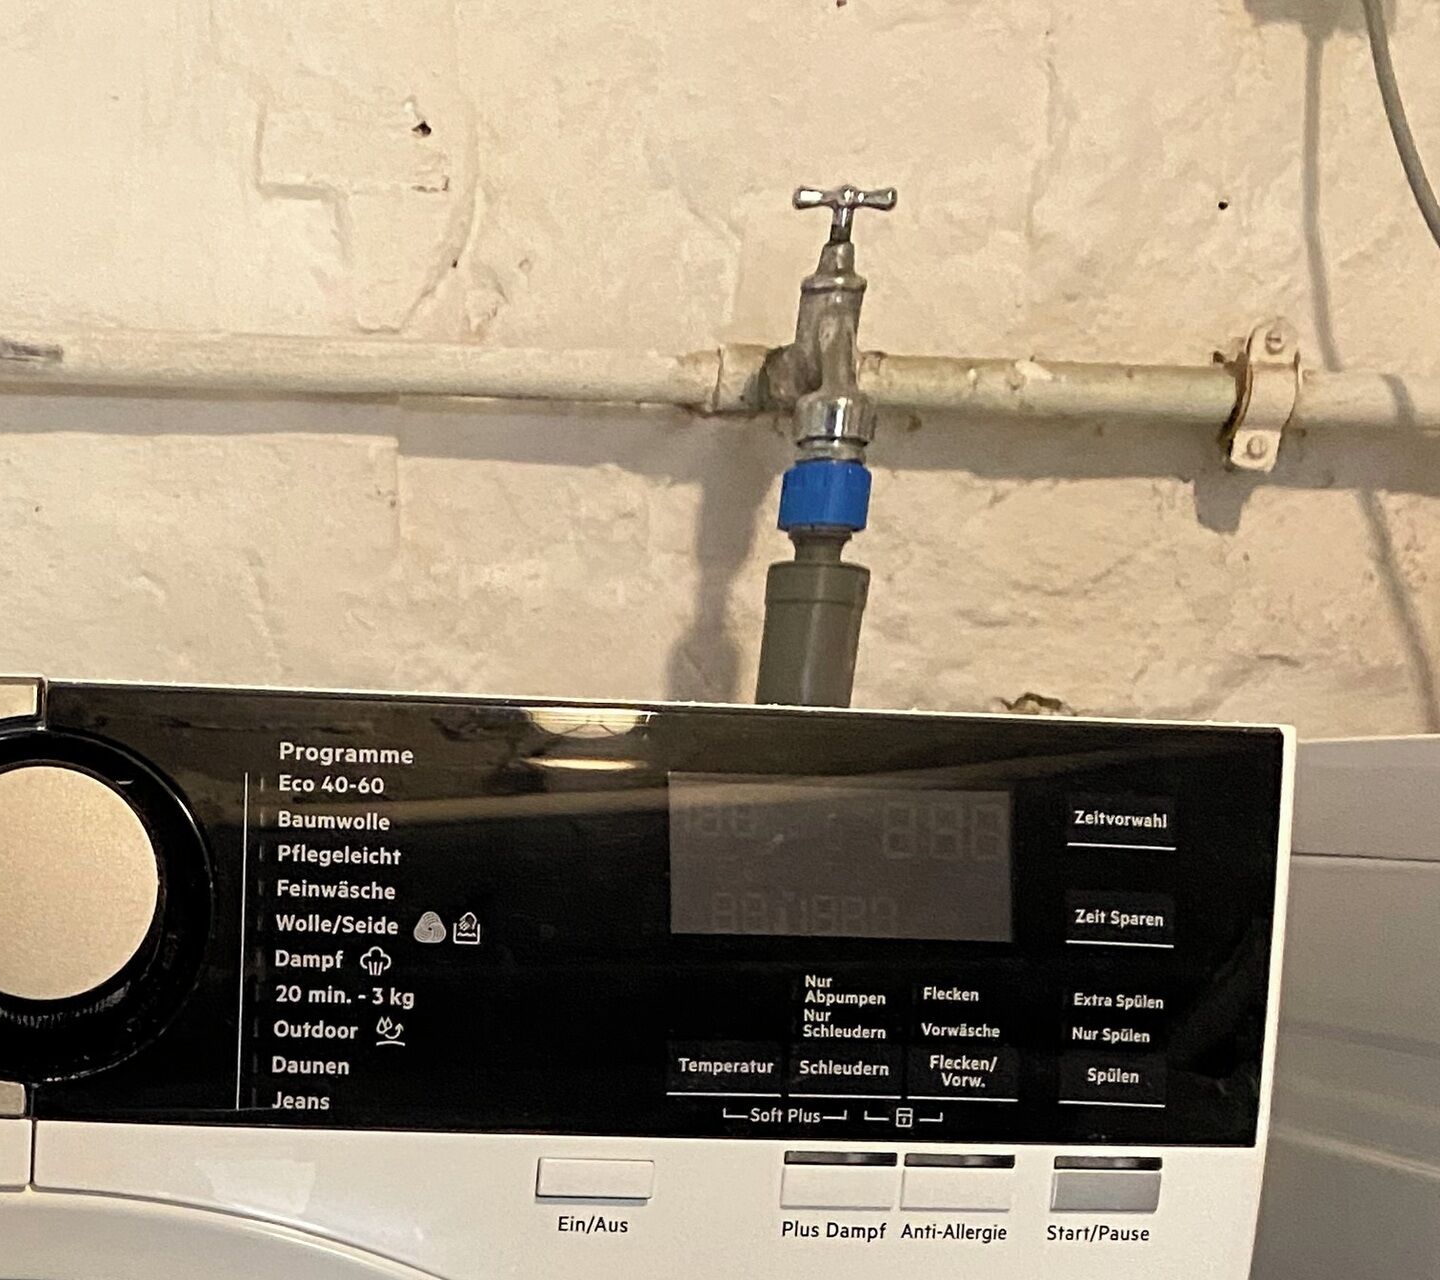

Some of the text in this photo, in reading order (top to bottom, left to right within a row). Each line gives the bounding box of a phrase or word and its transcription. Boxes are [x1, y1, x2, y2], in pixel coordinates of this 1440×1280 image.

[278, 742, 414, 765] Programme
[278, 775, 385, 794] Eco 40-60
[278, 811, 390, 831] Baumwolle
[1074, 810, 1168, 829] Zeitvorwahl
[277, 846, 402, 866] Pflegeleicht
[277, 879, 396, 900] Feinwäsche
[276, 914, 399, 935] Wolle/Seide
[1074, 908, 1164, 929] Zeit Sparen
[275, 950, 344, 972] Dampf
[804, 975, 833, 989] Nur
[275, 985, 302, 1003] 20
[308, 985, 352, 1004] min.
[371, 988, 383, 1005] 3
[389, 987, 415, 1009] kg
[804, 990, 887, 1009] Abpumpen
[923, 987, 980, 1002] Flecken
[1073, 992, 1164, 1011] Extra Spülen
[803, 1009, 832, 1022] Nur
[273, 1020, 358, 1040] Outdoor
[802, 1023, 887, 1040] Schleudern
[921, 1022, 1001, 1039] Vorwäsche
[1071, 1026, 1151, 1045] Nur Spülen
[272, 1056, 350, 1077] Daunen
[678, 1057, 775, 1077] Temperatur
[799, 1059, 890, 1078] Schleudern
[929, 1054, 998, 1072] Flecken/
[941, 1072, 987, 1089] Vorw.
[1087, 1067, 1140, 1086] Spülen
[272, 1091, 330, 1112] Jeans
[750, 1108, 821, 1124] Soft Plus
[558, 1216, 629, 1234] Ein/Aus
[781, 1221, 887, 1244] Plus Dampf
[900, 1224, 1008, 1243] Anti-Allergie
[1046, 1225, 1150, 1243] Start/Pause
